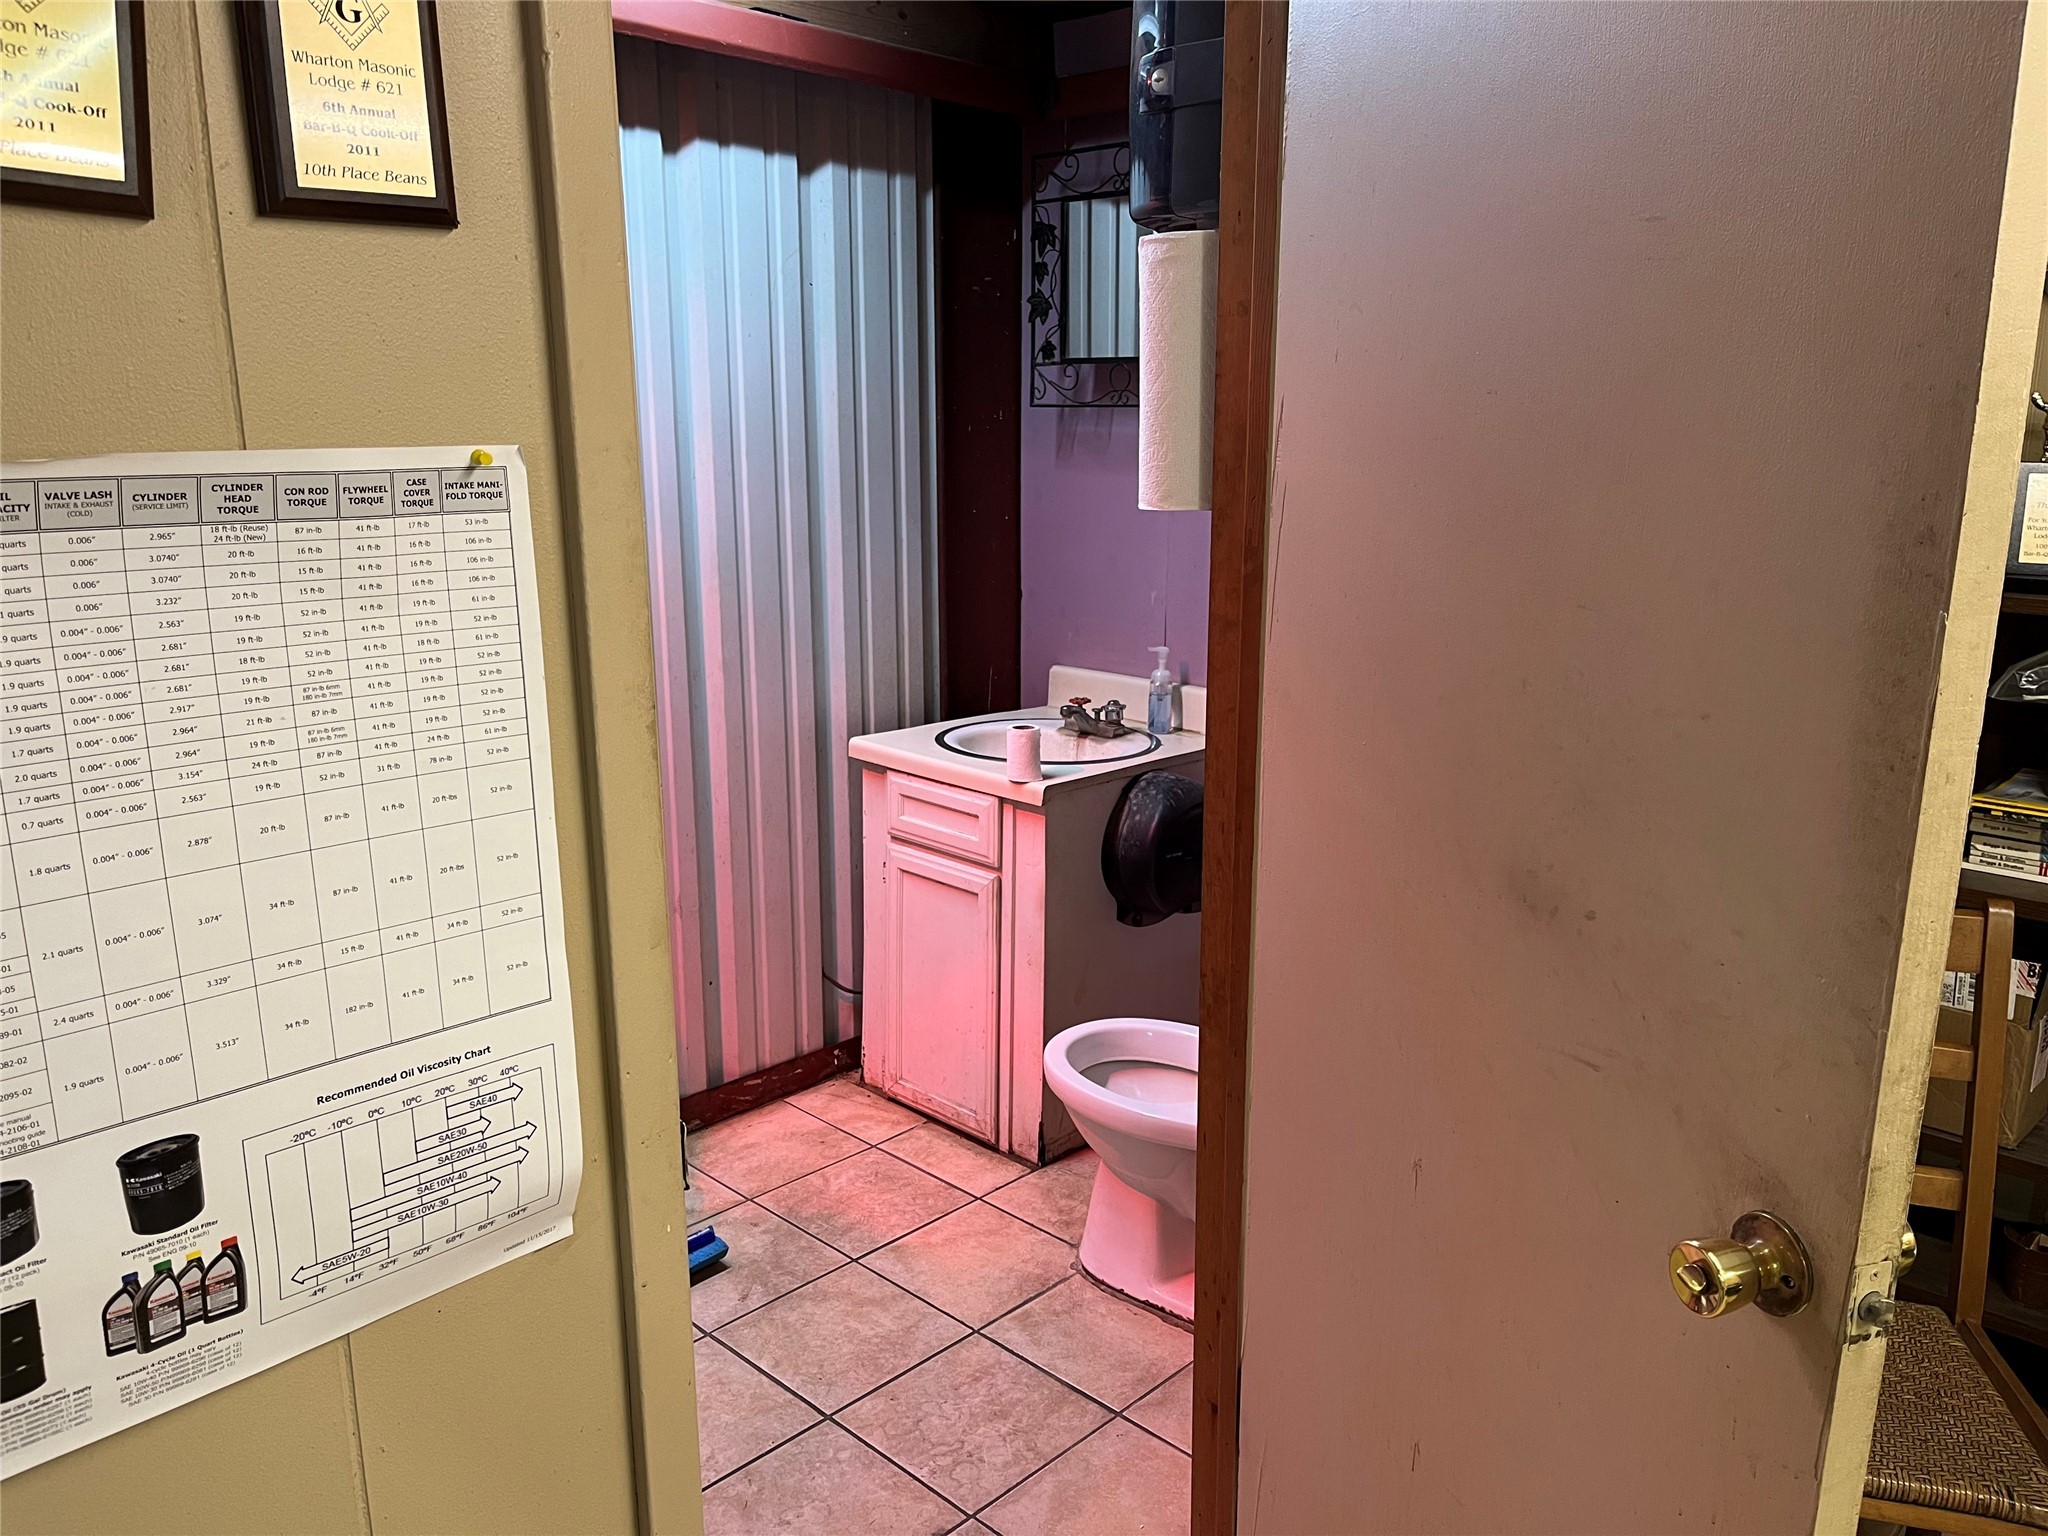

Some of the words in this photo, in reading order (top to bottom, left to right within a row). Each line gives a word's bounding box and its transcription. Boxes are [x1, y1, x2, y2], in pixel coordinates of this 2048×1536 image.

[291, 50, 353, 70] Wharton
[358, 58, 416, 78] Masonic
[309, 72, 355, 92] Lodge
[361, 78, 371, 91] #
[376, 81, 403, 96] 621
[34, 97, 108, 118] Cook-Off
[323, 101, 345, 114] 6th
[350, 104, 396, 119] Annual
[13, 116, 56, 133] 2011
[303, 119, 357, 137] Bar-B-Q
[361, 126, 418, 142] Cook-Off
[346, 143, 380, 156] 2011
[303, 162, 336, 177] 10th
[342, 166, 380, 181] Place
[384, 169, 427, 185] Beans
[211, 483, 264, 493] CYLINDER
[406, 478, 427, 487] CASE
[444, 482, 471, 490] INTAKE
[474, 480, 503, 490] MANI-
[284, 487, 305, 497] CON
[308, 486, 329, 496] ROD
[342, 484, 389, 495] FLYWHEEL
[404, 488, 431, 498] COVER
[44, 492, 81, 501] VALVE
[84, 490, 113, 500] LASH
[132, 492, 188, 502] CYLINDER
[224, 494, 252, 503] HEAD
[348, 496, 385, 506] TORQUE
[446, 492, 467, 501] FOLD
[471, 490, 504, 500] TORQUE
[44, 502, 71, 510] INTAKE
[80, 501, 114, 509] EXHAUST
[132, 502, 162, 511] (SERVICE
[164, 502, 189, 510] LIMIT)
[286, 498, 328, 508] TORQUE
[401, 498, 434, 508] TORQUE
[66, 510, 93, 519] (COLD)
[216, 505, 260, 515] TORQUE
[210, 526, 220, 534] 18
[240, 524, 269, 533] (Reuse)
[68, 536, 96, 545] 0.006"
[243, 534, 266, 543] (New)
[70, 558, 98, 568] 0.006"
[2, 682, 15, 691] 1.9
[18, 680, 45, 690] quarts
[12, 750, 25, 758] 1.7
[27, 746, 54, 757] quarts
[15, 774, 28, 783] 2.0
[42, 952, 55, 960] 2.1
[58, 946, 84, 957] quarts
[317, 1073, 397, 1106] Recommended
[400, 1068, 415, 1080] Oil
[417, 1056, 462, 1074] Viscosity
[464, 1046, 492, 1060] Chart
[470, 1094, 498, 1109] SAE40
[438, 1128, 467, 1143] SAE30
[438, 1142, 488, 1165] SAE20W-50
[417, 1171, 468, 1195] SAE10W-40
[397, 1198, 449, 1223] SAE10W-30
[121, 1241, 155, 1257] Kawasaki
[156, 1230, 188, 1245] Standard
[190, 1225, 200, 1233] Oil
[201, 1220, 218, 1230] Filter
[28, 1258, 47, 1268] Filter
[322, 1247, 372, 1272] SAE5W-20
[116, 1365, 149, 1381] Kawasaki
